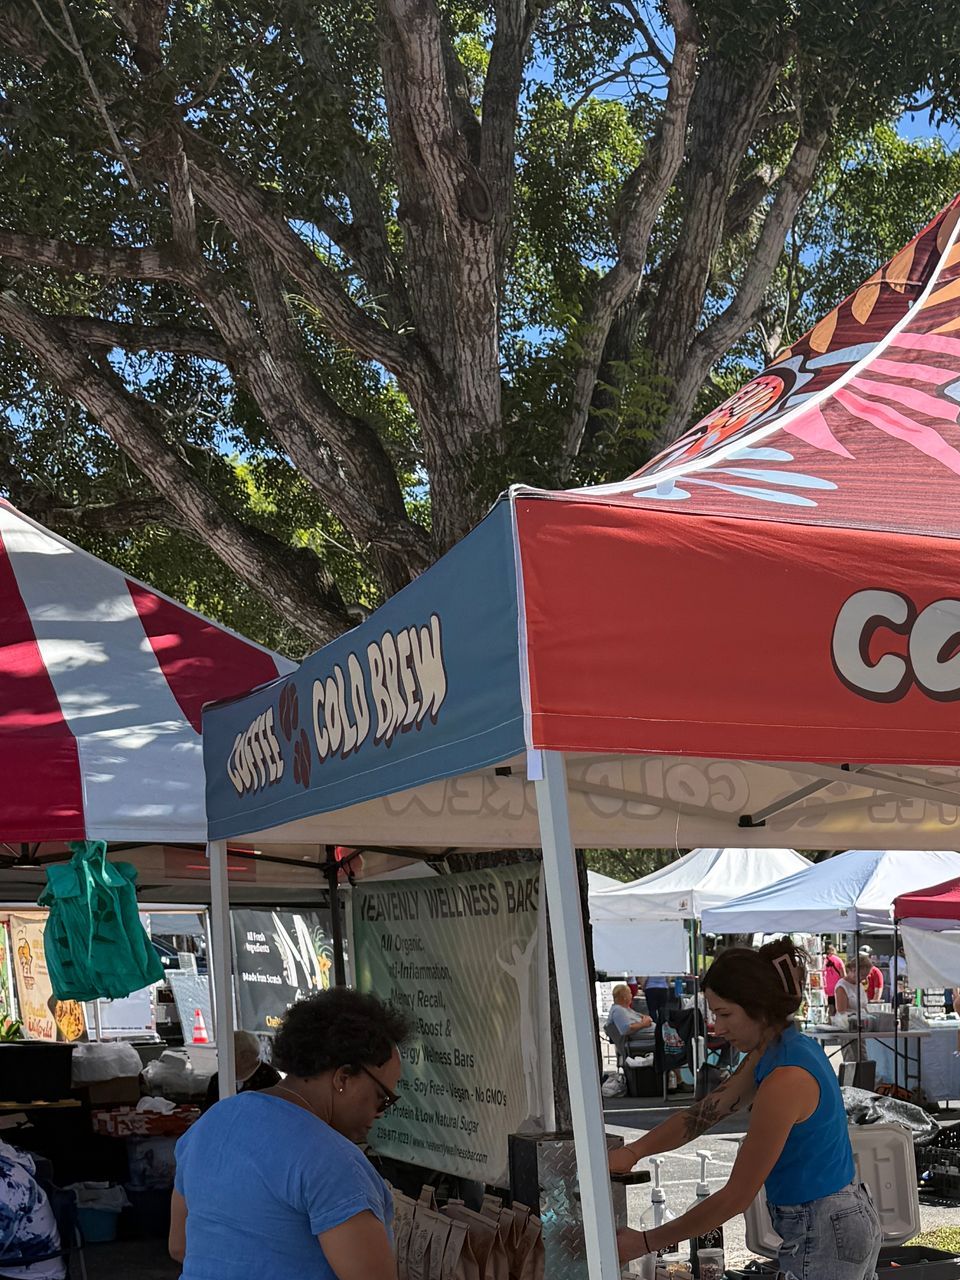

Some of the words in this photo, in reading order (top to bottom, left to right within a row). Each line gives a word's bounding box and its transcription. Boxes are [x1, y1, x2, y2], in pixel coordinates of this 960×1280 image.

[312, 651, 371, 764] COLD
[367, 611, 448, 749] BREW
[227, 706, 285, 798] COFFEE
[424, 882, 499, 919] WELLNESS
[381, 934, 393, 951] All
[401, 1046, 420, 1065] ergy
[454, 1047, 475, 1068] Bars
[475, 1087, 485, 1102] No
[435, 1112, 459, 1130] Natural
